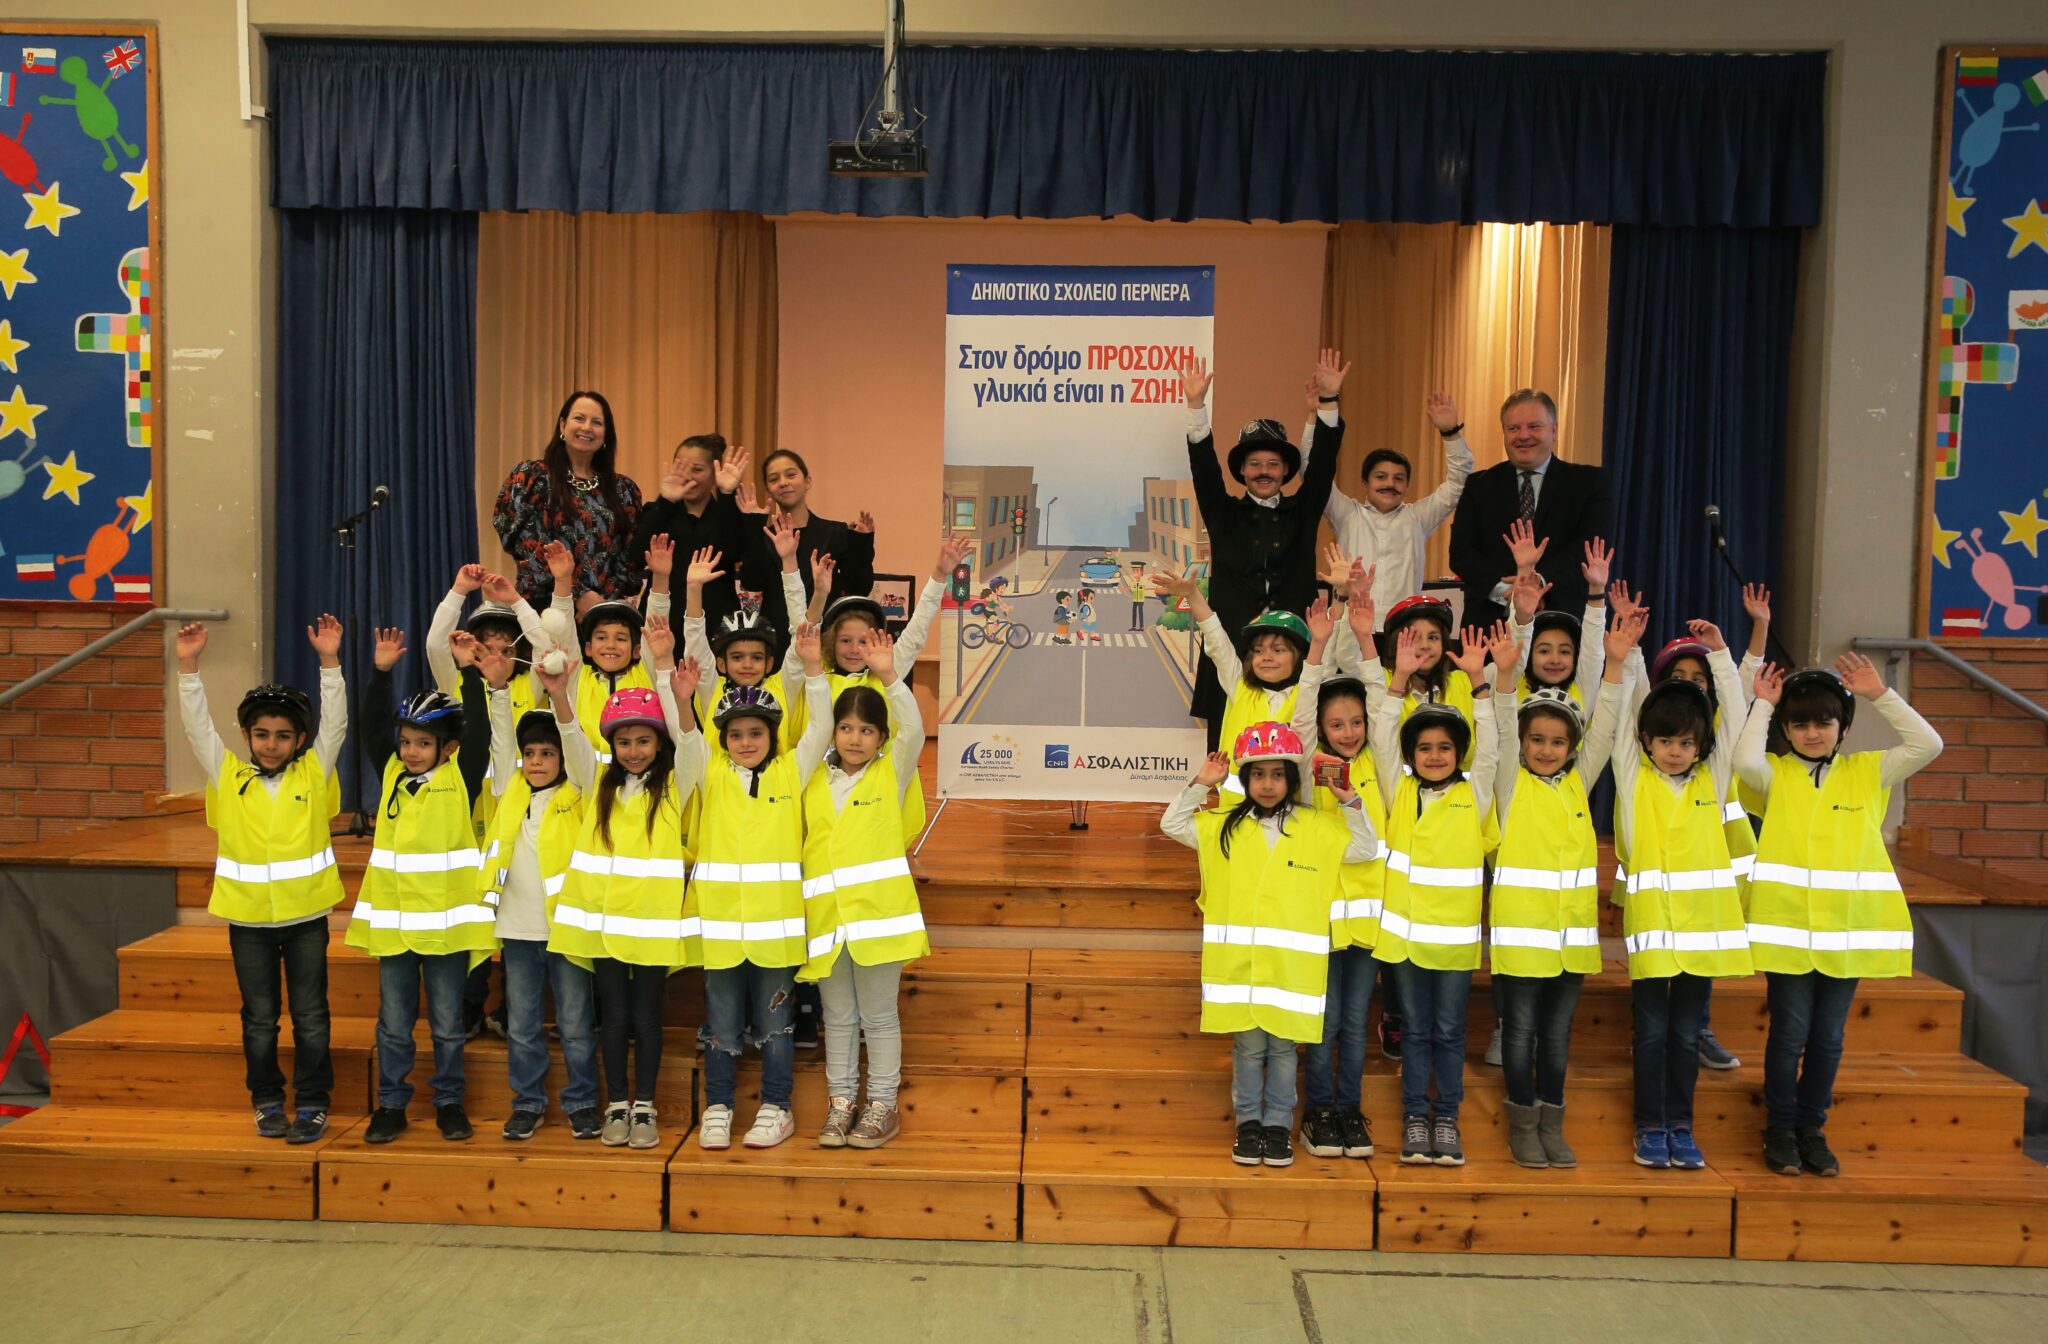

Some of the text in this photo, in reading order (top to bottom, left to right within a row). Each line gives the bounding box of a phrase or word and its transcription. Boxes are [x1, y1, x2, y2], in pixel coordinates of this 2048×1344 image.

[971, 282, 1191, 302] ΔΗΜΟΤΙΚΟ ΣΧΟΛΕΙΟ ΠΕΡΝΕΡΑ
[958, 344, 1195, 376] Στον δρόμο ΠΡΟΣΟΧΗ
[973, 377, 1184, 408] γλυκιά είναι η ΖΩΗ!
[980, 749, 1013, 759] 25 000
[1073, 755, 1189, 771] ΑΣΦΑΛΙΣΤΙΚΗ
